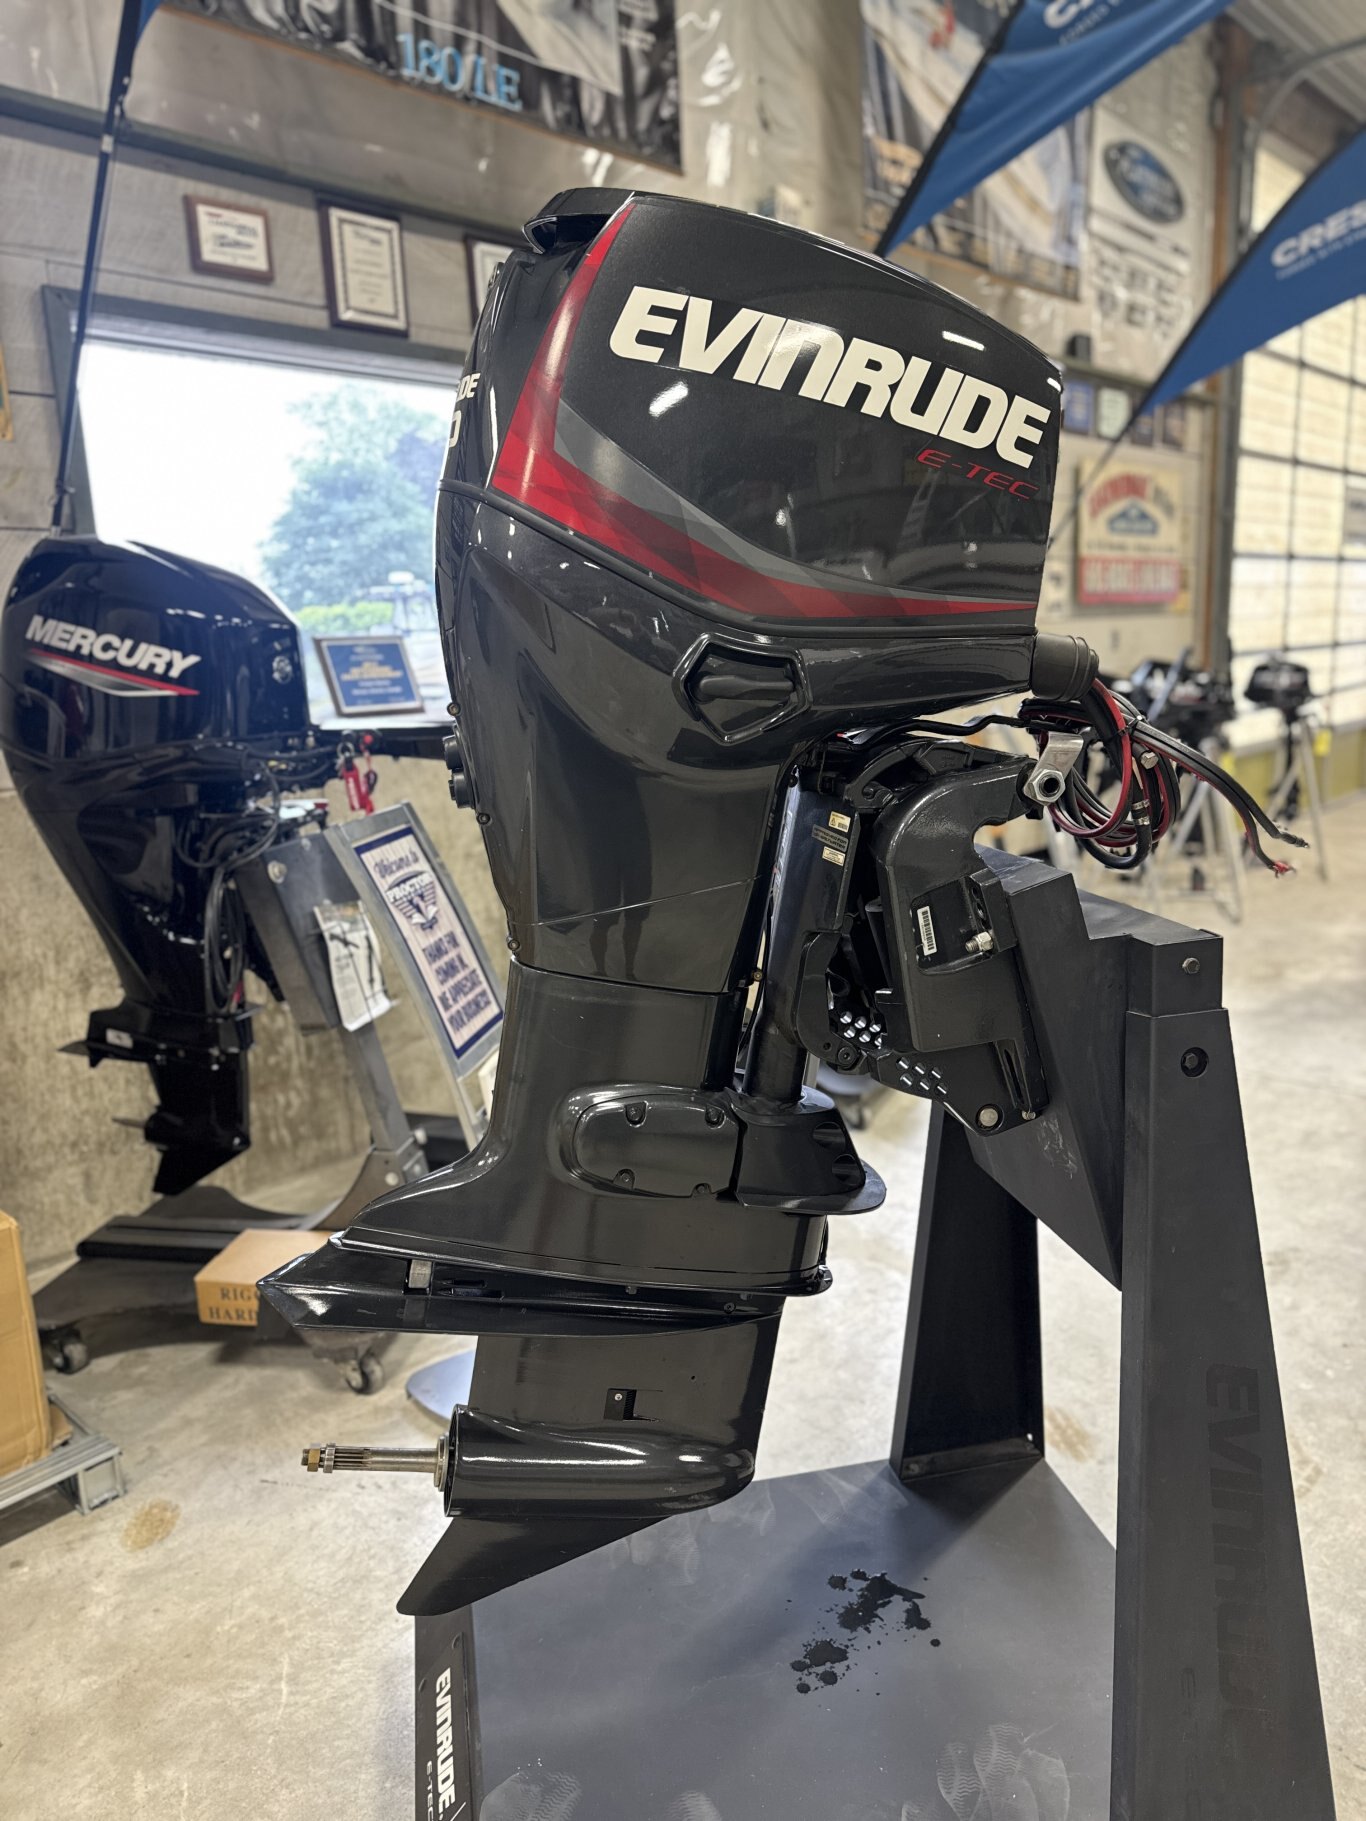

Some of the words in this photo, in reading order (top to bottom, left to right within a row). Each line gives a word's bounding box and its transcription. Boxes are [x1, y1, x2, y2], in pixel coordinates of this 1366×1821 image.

[396, 32, 464, 92] 180
[609, 285, 1051, 468] EVINRUDE
[917, 448, 1040, 500] E-TEC
[25, 614, 202, 679] MERCURY
[386, 873, 434, 903] PROCTOR
